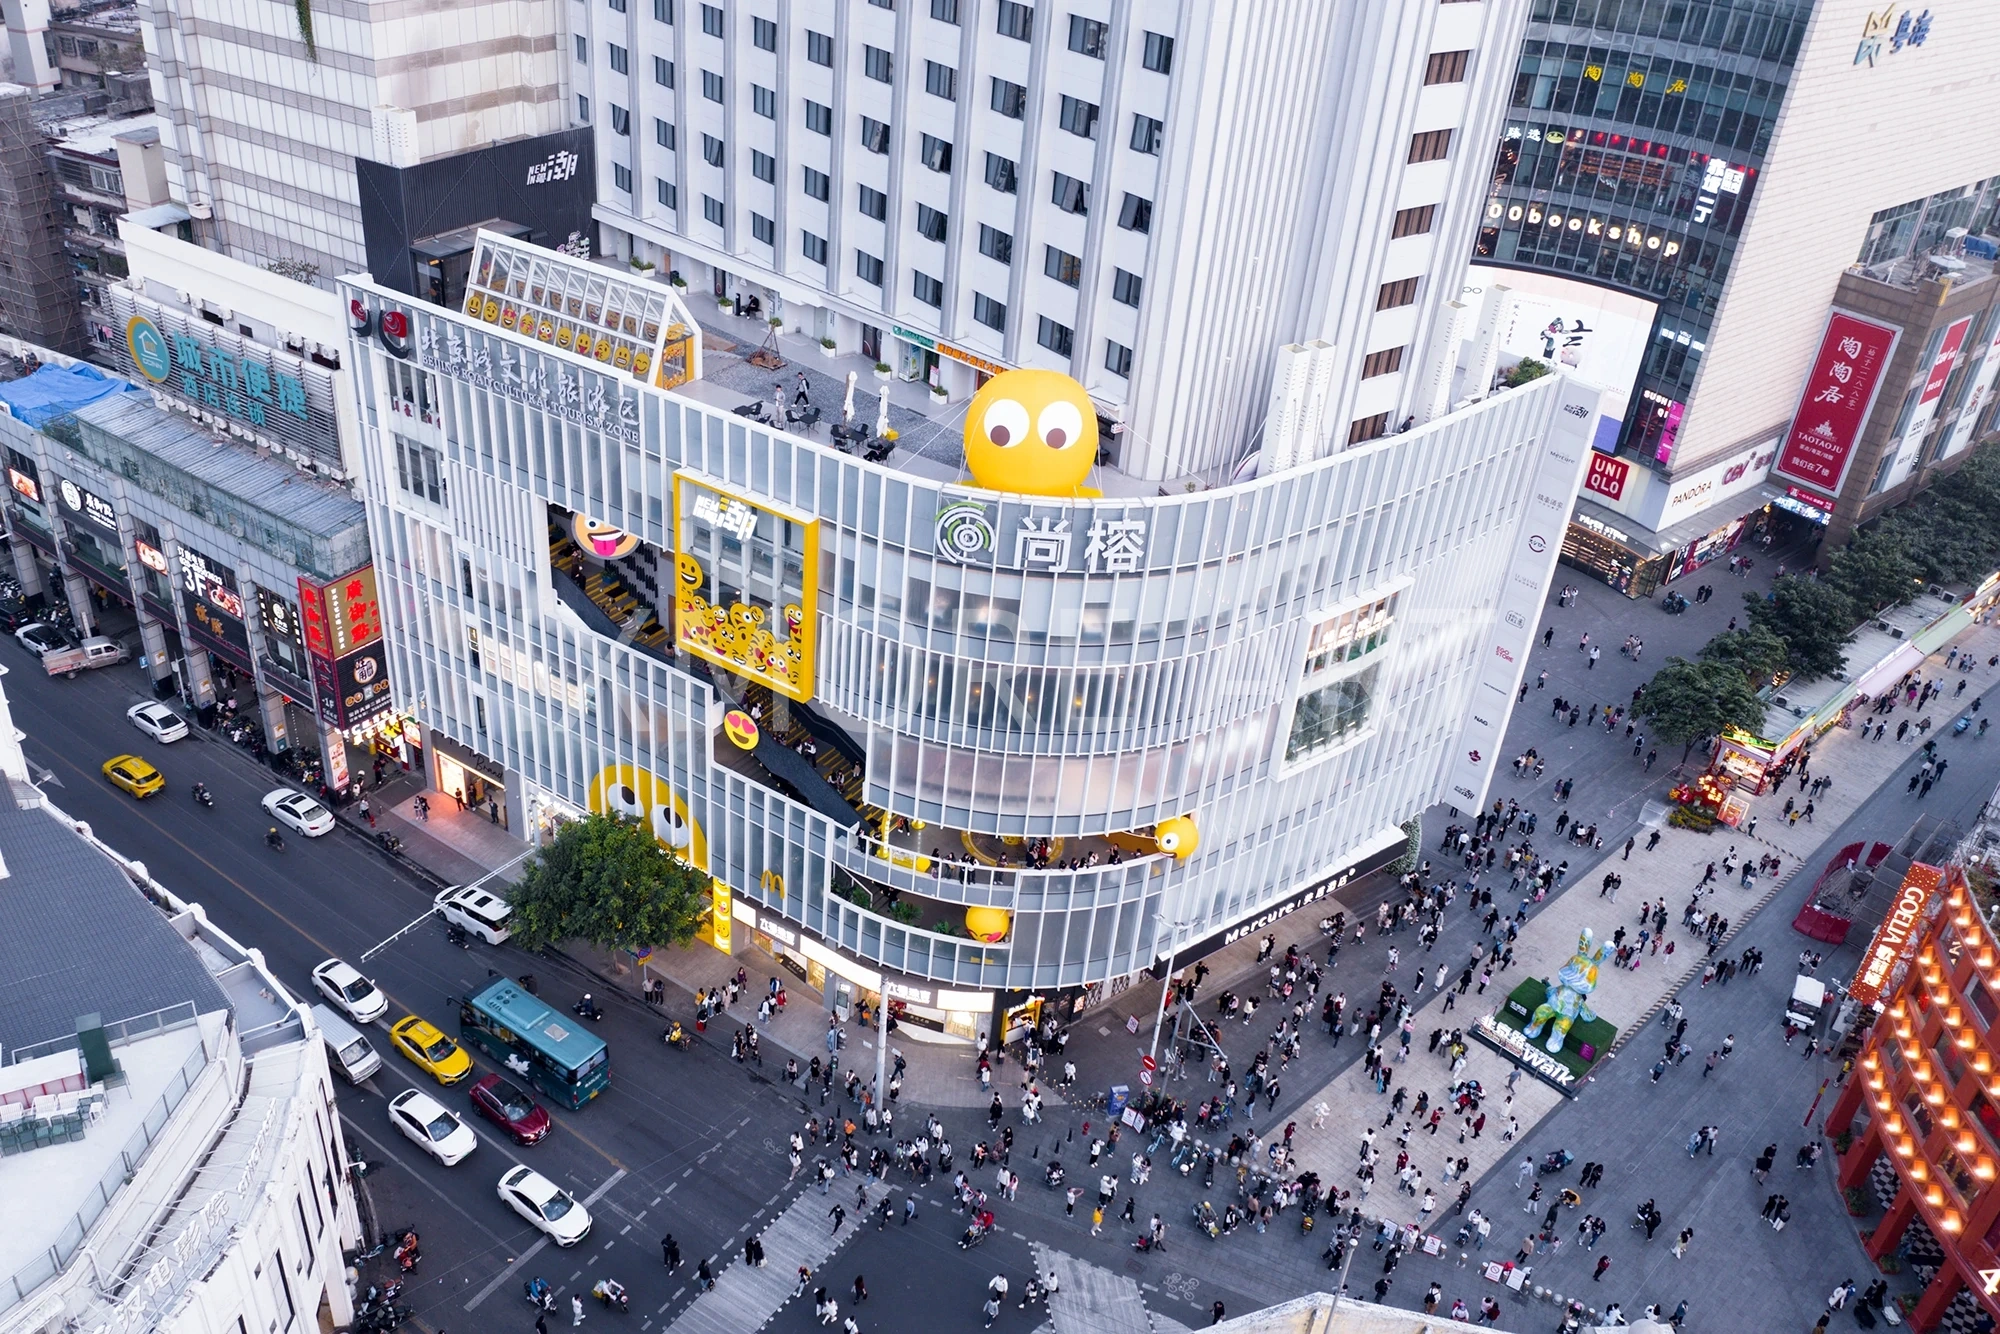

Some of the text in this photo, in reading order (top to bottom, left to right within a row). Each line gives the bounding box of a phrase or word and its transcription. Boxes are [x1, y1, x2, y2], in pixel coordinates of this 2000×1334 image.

[1584, 65, 1687, 95] 陶陶居
[174, 328, 308, 421] 城市便捷
[422, 327, 640, 426] 北京路文化旅游区
[1814, 335, 1862, 404] 陶陶居
[182, 372, 267, 427] 酒店连锁
[422, 354, 640, 443] BEIJING ROAD CULTURAL TOURISM ZONE
[1643, 389, 1672, 408] SUSHI
[1594, 458, 1623, 480] UNI
[1798, 431, 1843, 454] TAOTAOJU
[1591, 474, 1620, 495] QLO
[1013, 515, 1147, 575] 尚榕
[180, 565, 207, 597] 3F
[1224, 874, 1349, 945] Mercure 美居酒店
[1882, 886, 1925, 944] GOELIA
[1521, 1047, 1575, 1086] Walk
